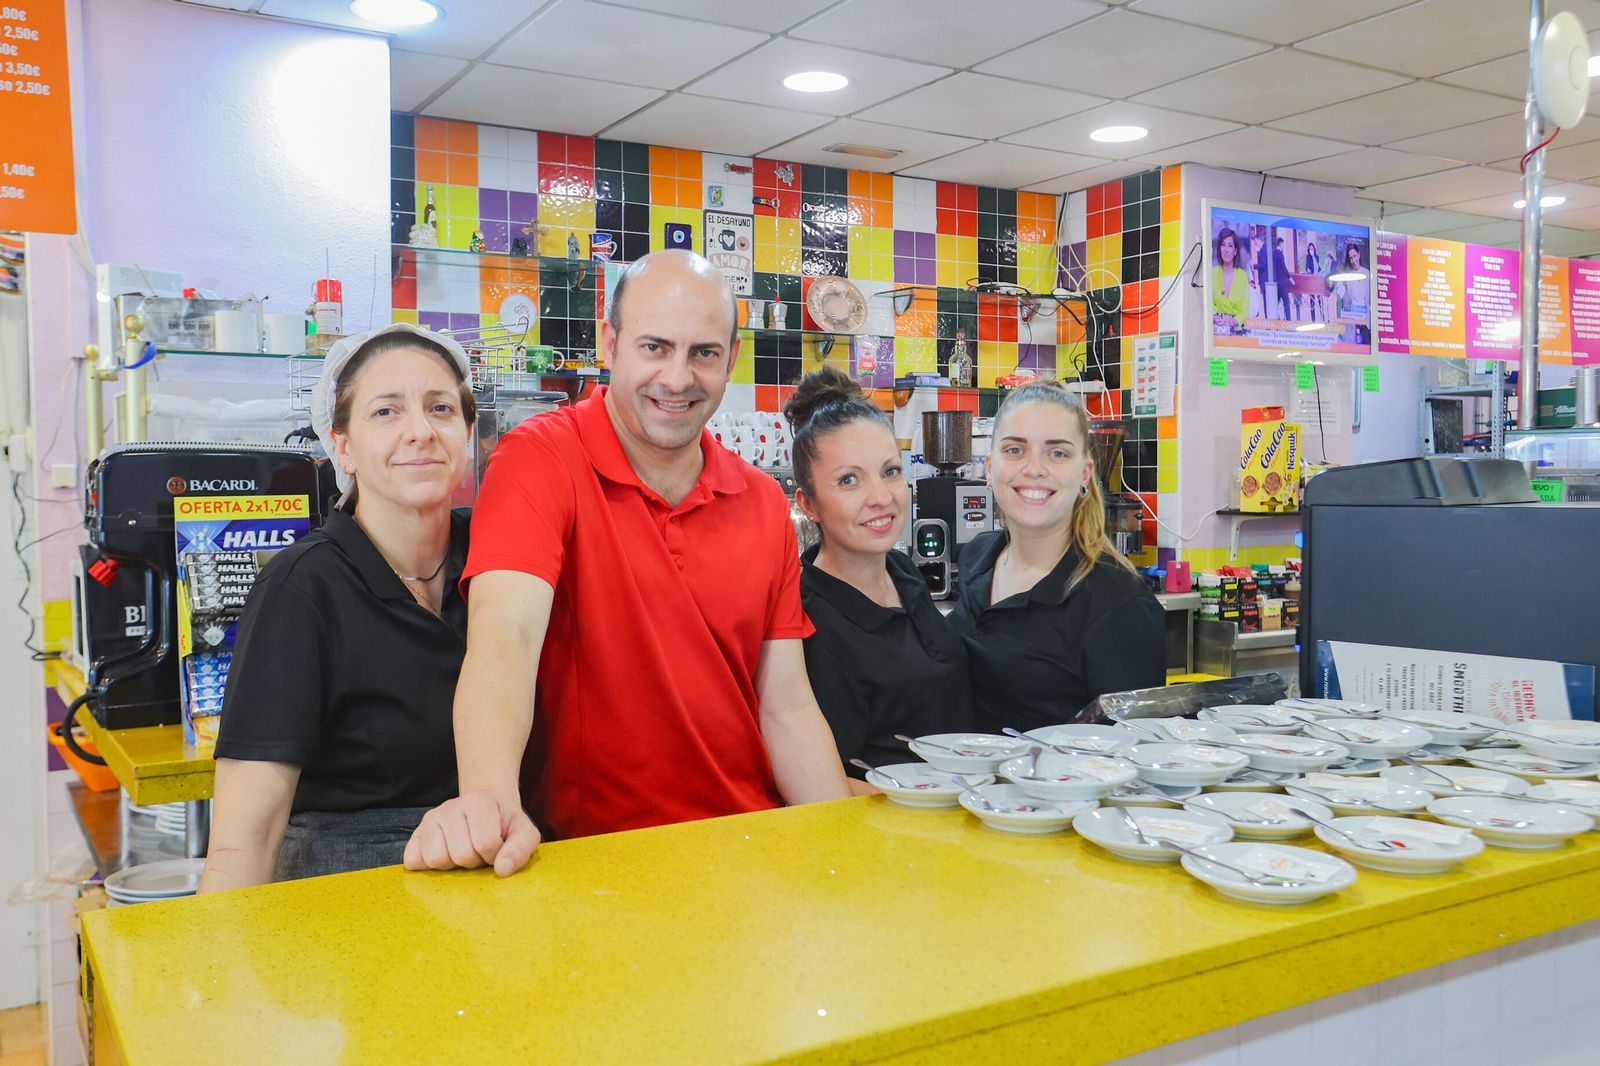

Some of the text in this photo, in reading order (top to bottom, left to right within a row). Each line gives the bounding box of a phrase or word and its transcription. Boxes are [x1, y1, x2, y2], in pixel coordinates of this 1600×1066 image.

[4, 25, 40, 41] 2,50€
[6, 61, 41, 77] 3,50€
[16, 80, 51, 96] 2,50€
[2, 162, 35, 177] 1,40€
[708, 214, 750, 228] EL DESAYUNO
[1240, 428, 1262, 470] ColaCao
[1260, 422, 1286, 469] ColaCao
[1287, 432, 1296, 470] Nesquik
[190, 480, 256, 491] BACARDI
[180, 498, 302, 514] OFERTA 2x1,70€
[222, 529, 296, 548] HALLS
[215, 553, 252, 562] HALLS
[218, 564, 254, 573] HALLS
[220, 574, 256, 583] HALLS
